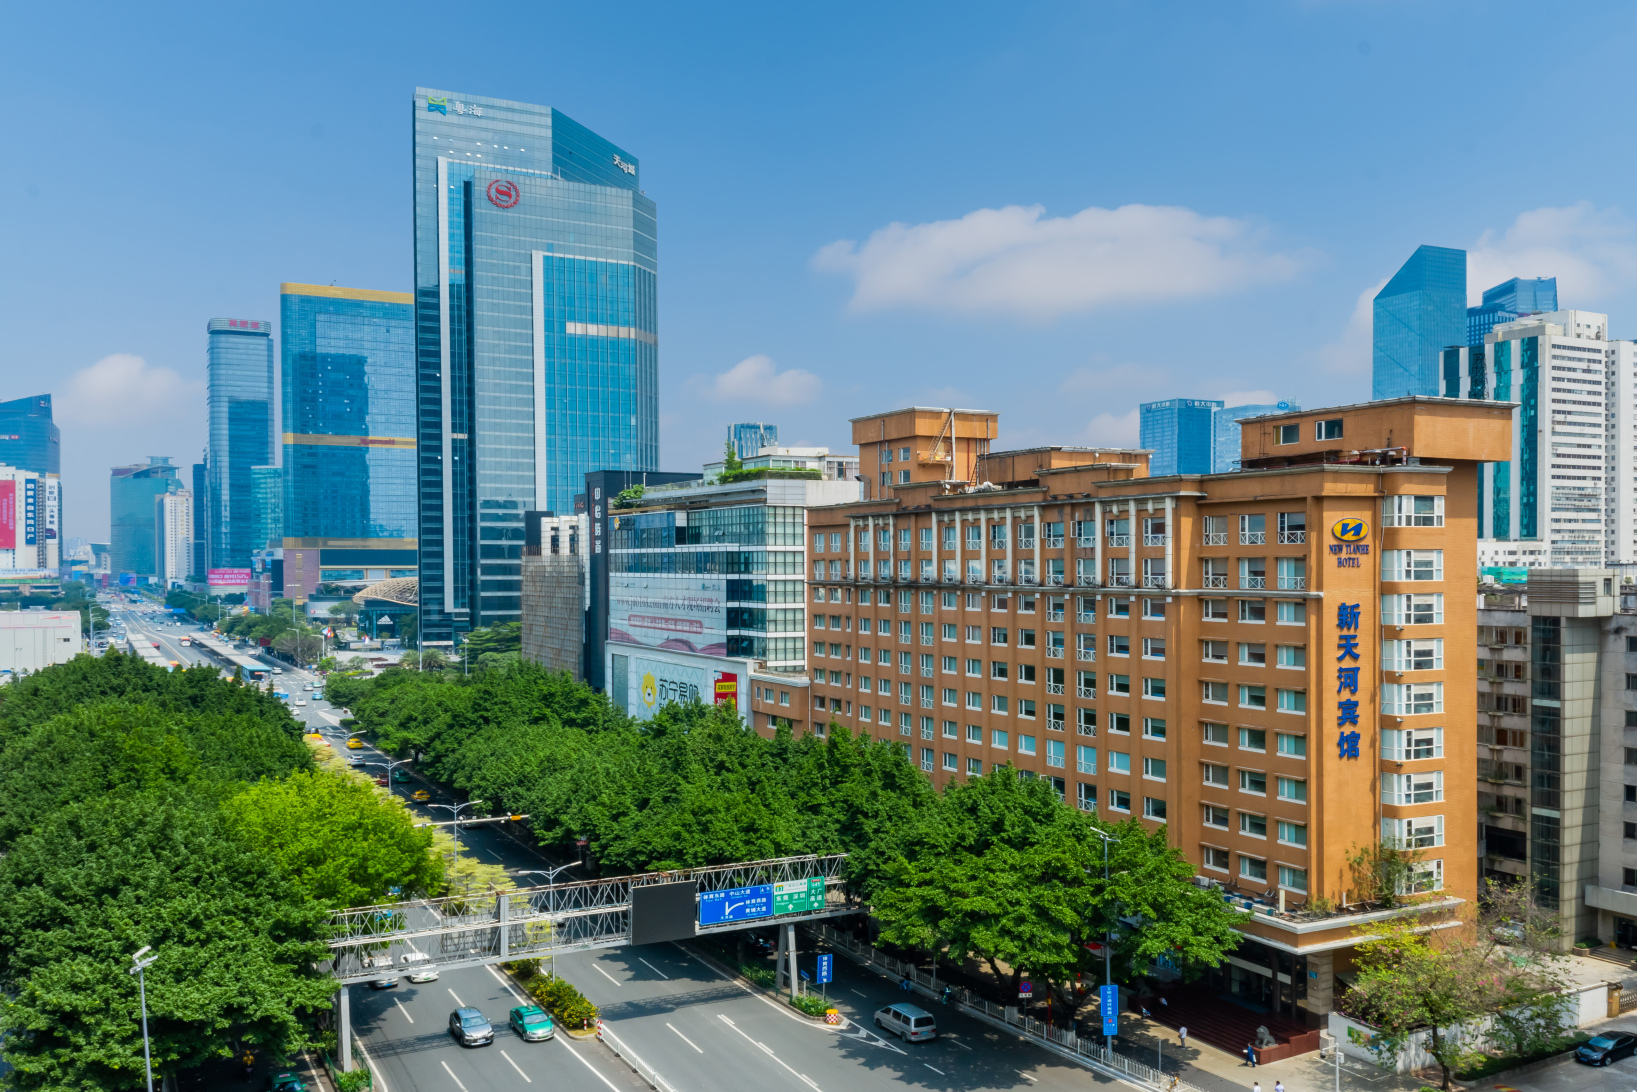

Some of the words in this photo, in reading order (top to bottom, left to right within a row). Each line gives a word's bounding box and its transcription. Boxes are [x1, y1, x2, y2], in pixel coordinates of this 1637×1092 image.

[453, 101, 483, 117] 粤海
[613, 154, 636, 177] 天河城
[495, 184, 512, 202] S
[1329, 544, 1344, 555] NEW
[1345, 544, 1370, 555] TIANHE
[1337, 557, 1361, 568] HOTEL
[1337, 602, 1362, 759] 新天河宾馆
